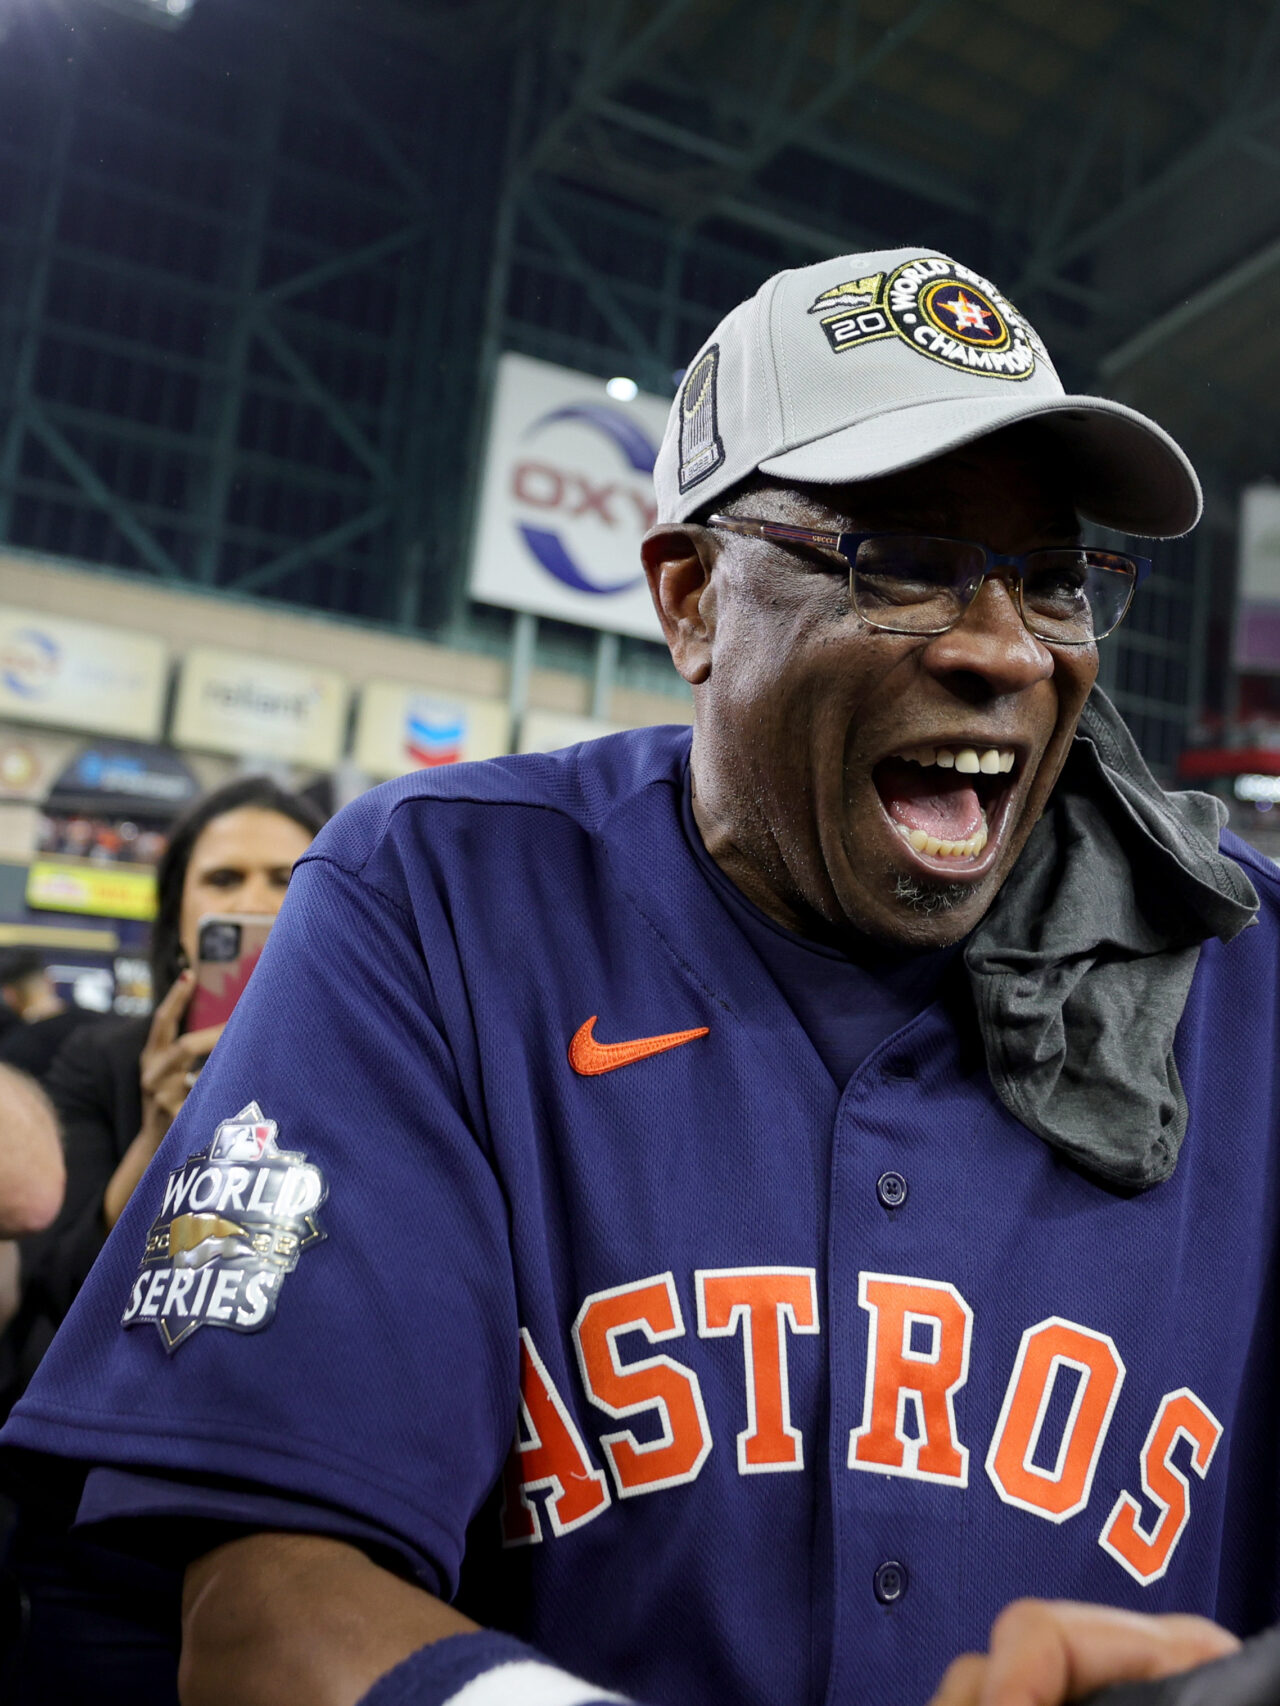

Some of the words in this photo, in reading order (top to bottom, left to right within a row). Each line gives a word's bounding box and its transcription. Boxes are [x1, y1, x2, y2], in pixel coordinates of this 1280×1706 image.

[891, 259, 950, 312] WORLD
[831, 312, 887, 342] 20
[161, 1166, 322, 1218] WORLD
[124, 1268, 277, 1326] SERIES
[501, 1265, 1224, 1586] ASTROS
